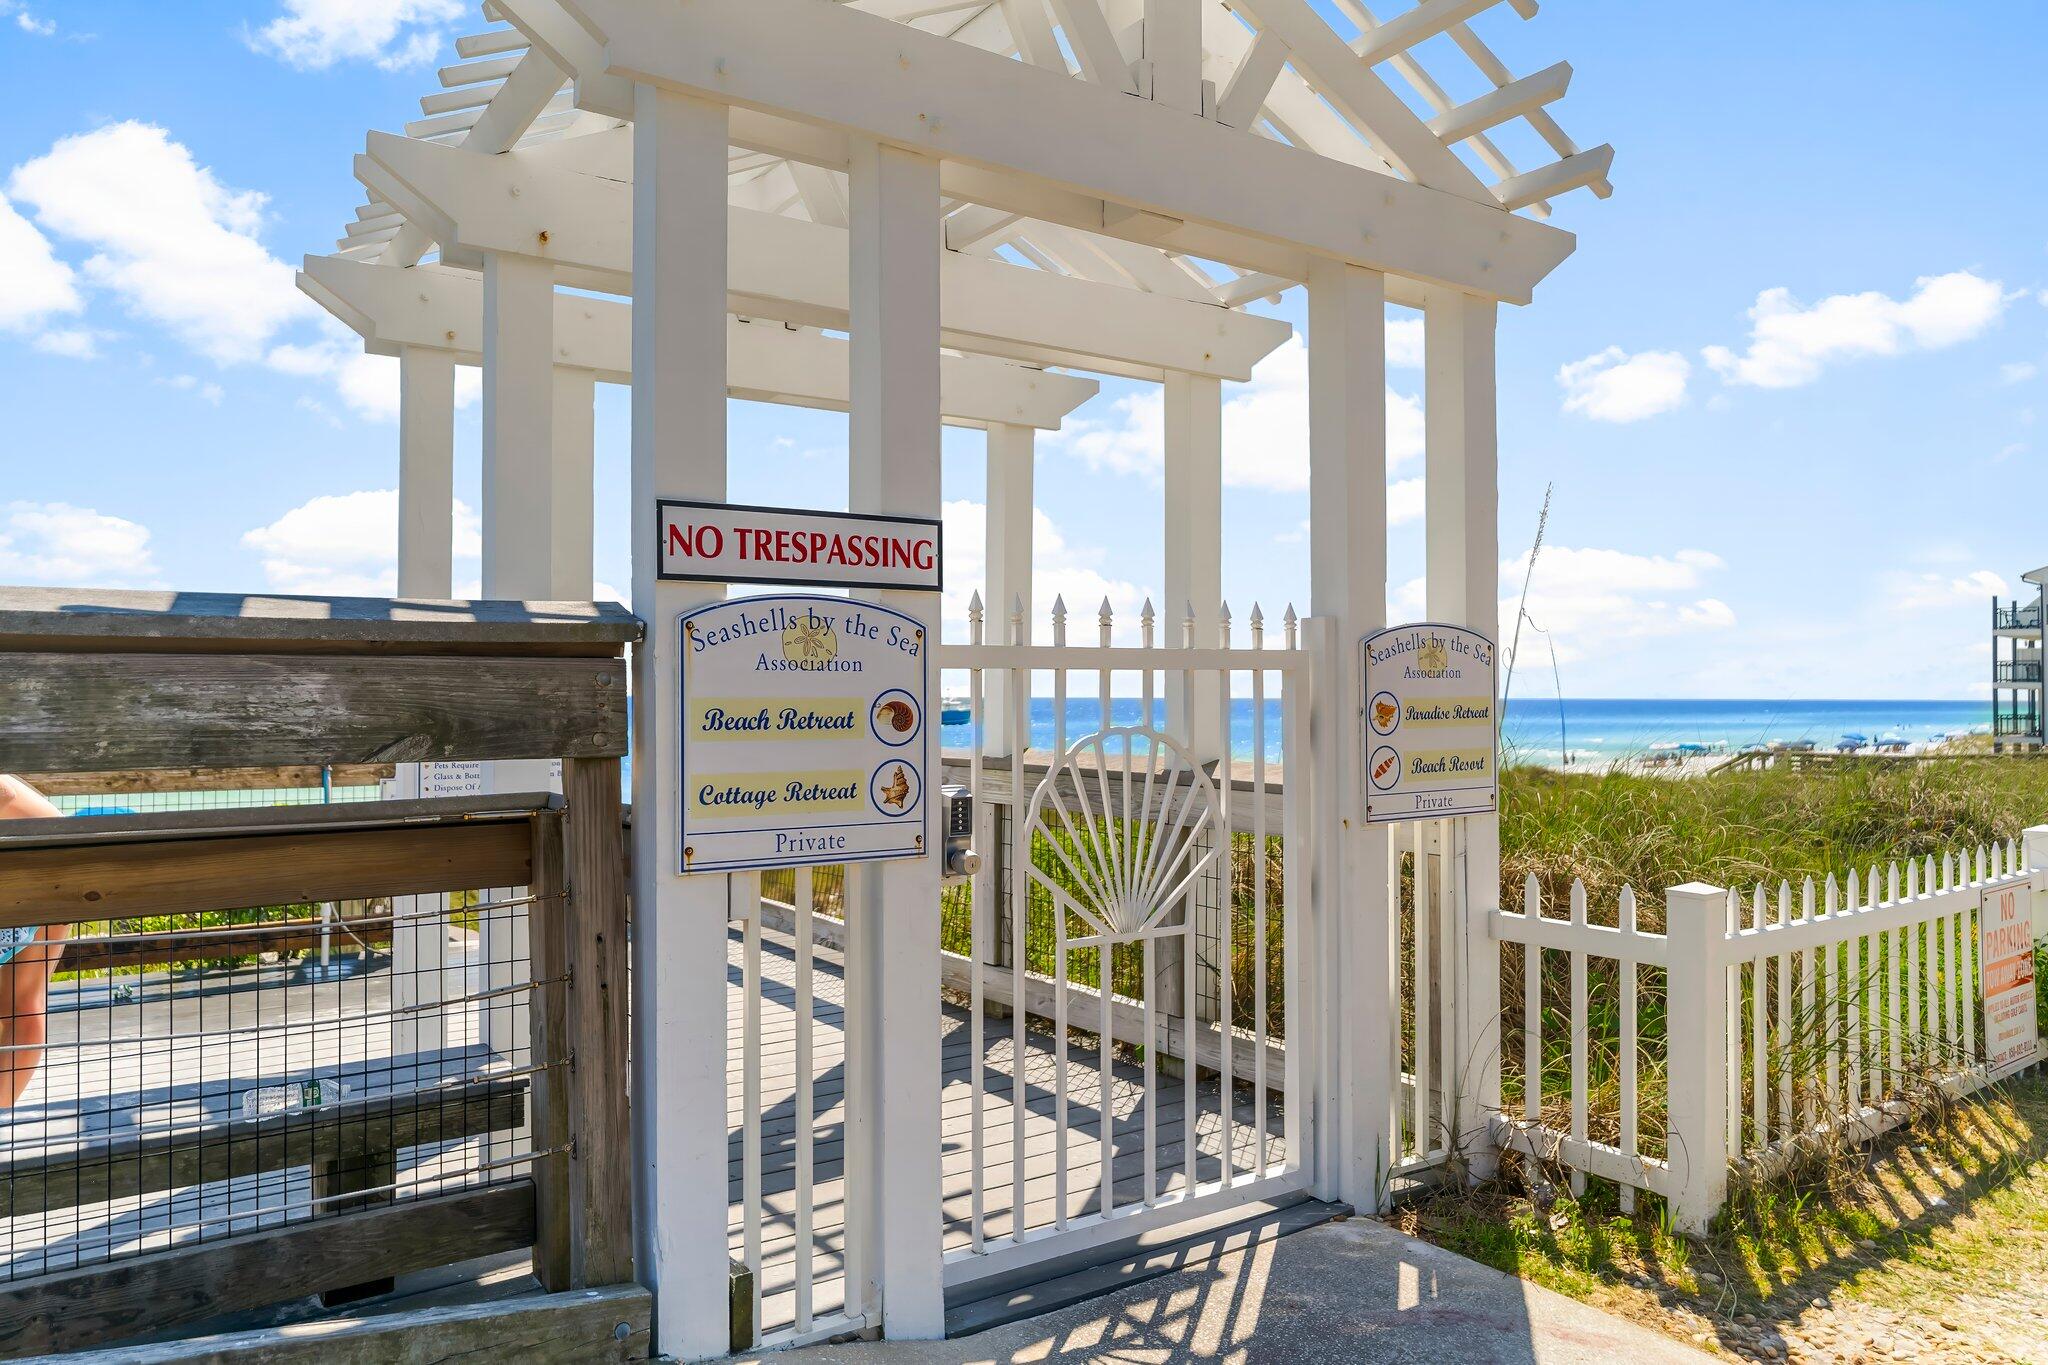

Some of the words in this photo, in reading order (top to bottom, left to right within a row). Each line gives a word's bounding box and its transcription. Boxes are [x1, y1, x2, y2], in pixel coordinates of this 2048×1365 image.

[669, 524, 723, 559] NO
[733, 528, 933, 570] TRESPASSING
[690, 607, 797, 653] Seashells
[808, 607, 835, 637] by
[845, 614, 879, 640] the
[887, 626, 919, 657] Sea
[1368, 633, 1426, 667] Seashells
[1431, 632, 1446, 652] by
[1450, 636, 1469, 655] the
[1473, 642, 1492, 667] Sea
[755, 653, 863, 672] Association
[1404, 666, 1461, 679] Association
[702, 707, 771, 731] Beach
[776, 707, 855, 731] Retreat
[1405, 705, 1450, 721] Paradise
[1453, 704, 1489, 719] Retreat
[1411, 757, 1446, 774] Beach
[1449, 755, 1485, 772] Resort
[433, 772, 453, 780] Glass
[434, 784, 463, 793] Dispose
[699, 785, 777, 810] Cottage
[784, 781, 858, 802] Retreat
[1415, 794, 1453, 809] Private
[776, 832, 846, 852] Private
[2001, 892, 2015, 921] NO
[1986, 920, 2031, 960] PARKING
